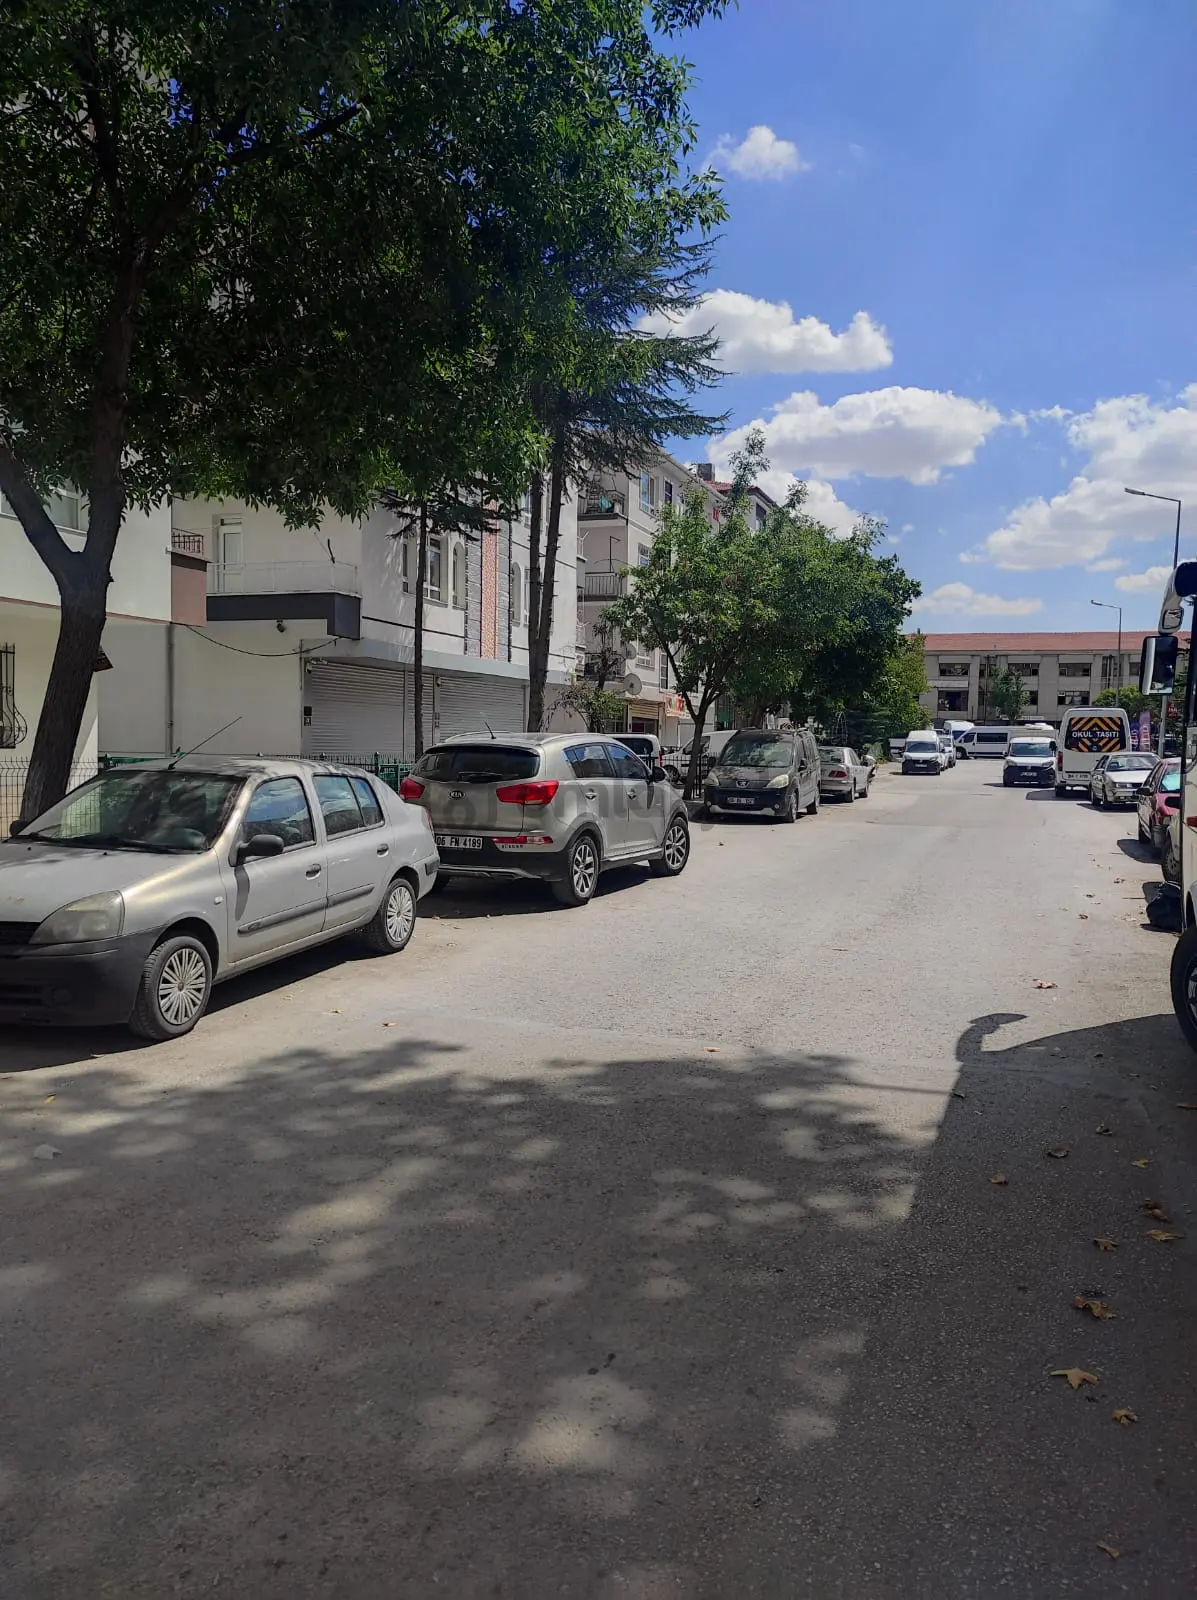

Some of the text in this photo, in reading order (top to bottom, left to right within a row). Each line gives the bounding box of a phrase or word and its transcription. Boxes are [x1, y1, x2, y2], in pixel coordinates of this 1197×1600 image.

[436, 836, 481, 848] 06 FN 4189
